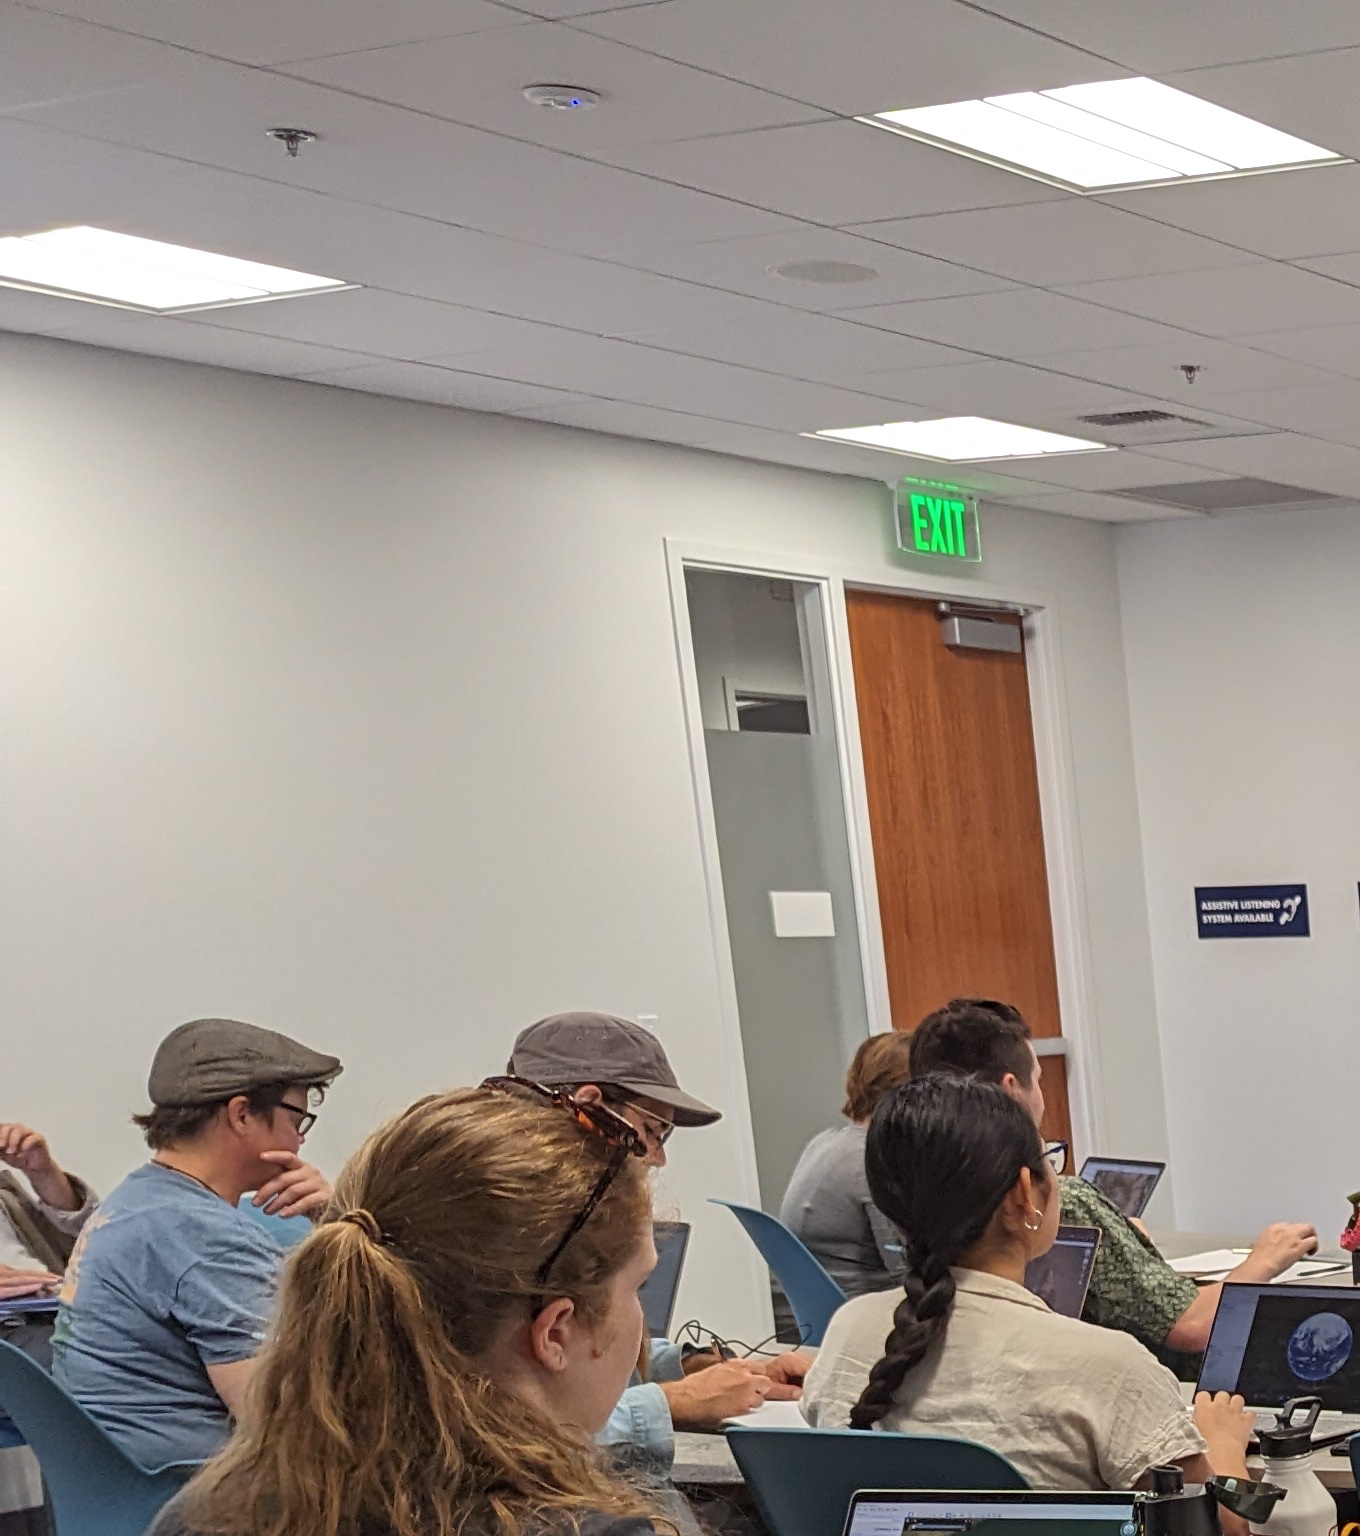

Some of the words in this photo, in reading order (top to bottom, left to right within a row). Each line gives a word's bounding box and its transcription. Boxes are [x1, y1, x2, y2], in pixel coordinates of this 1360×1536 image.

[911, 494, 965, 556] EXIT
[1201, 900, 1240, 911] ASSISTIVE
[1240, 899, 1280, 910] LISTENING
[1202, 913, 1233, 924] SYSTEM
[1234, 912, 1274, 923] AVAILABLE
